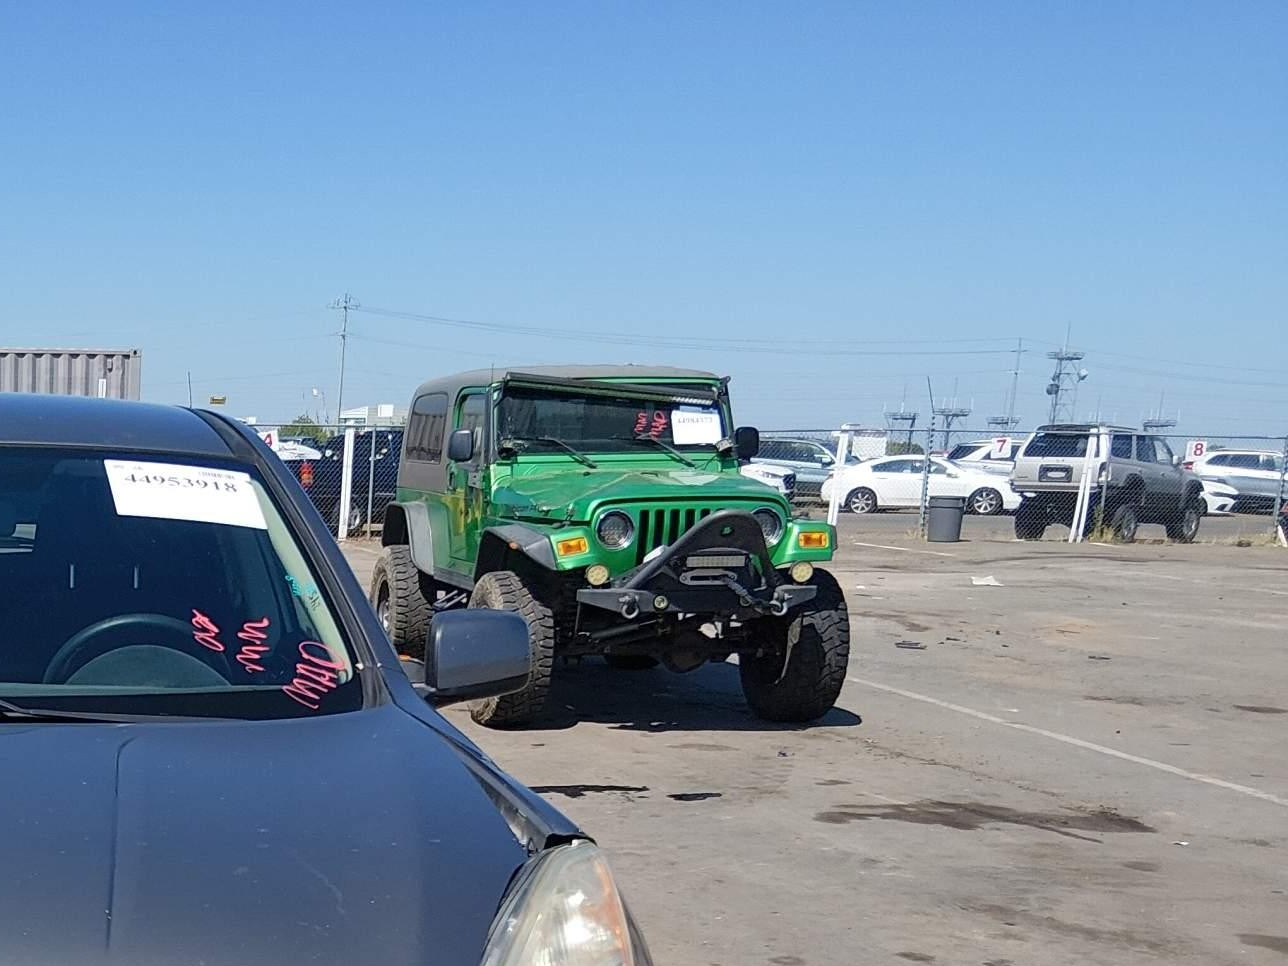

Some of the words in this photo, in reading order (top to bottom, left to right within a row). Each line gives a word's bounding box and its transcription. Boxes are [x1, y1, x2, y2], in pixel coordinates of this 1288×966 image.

[996, 438, 1008, 453] 7
[1193, 442, 1204, 457] 8
[123, 473, 238, 493] 44953918
